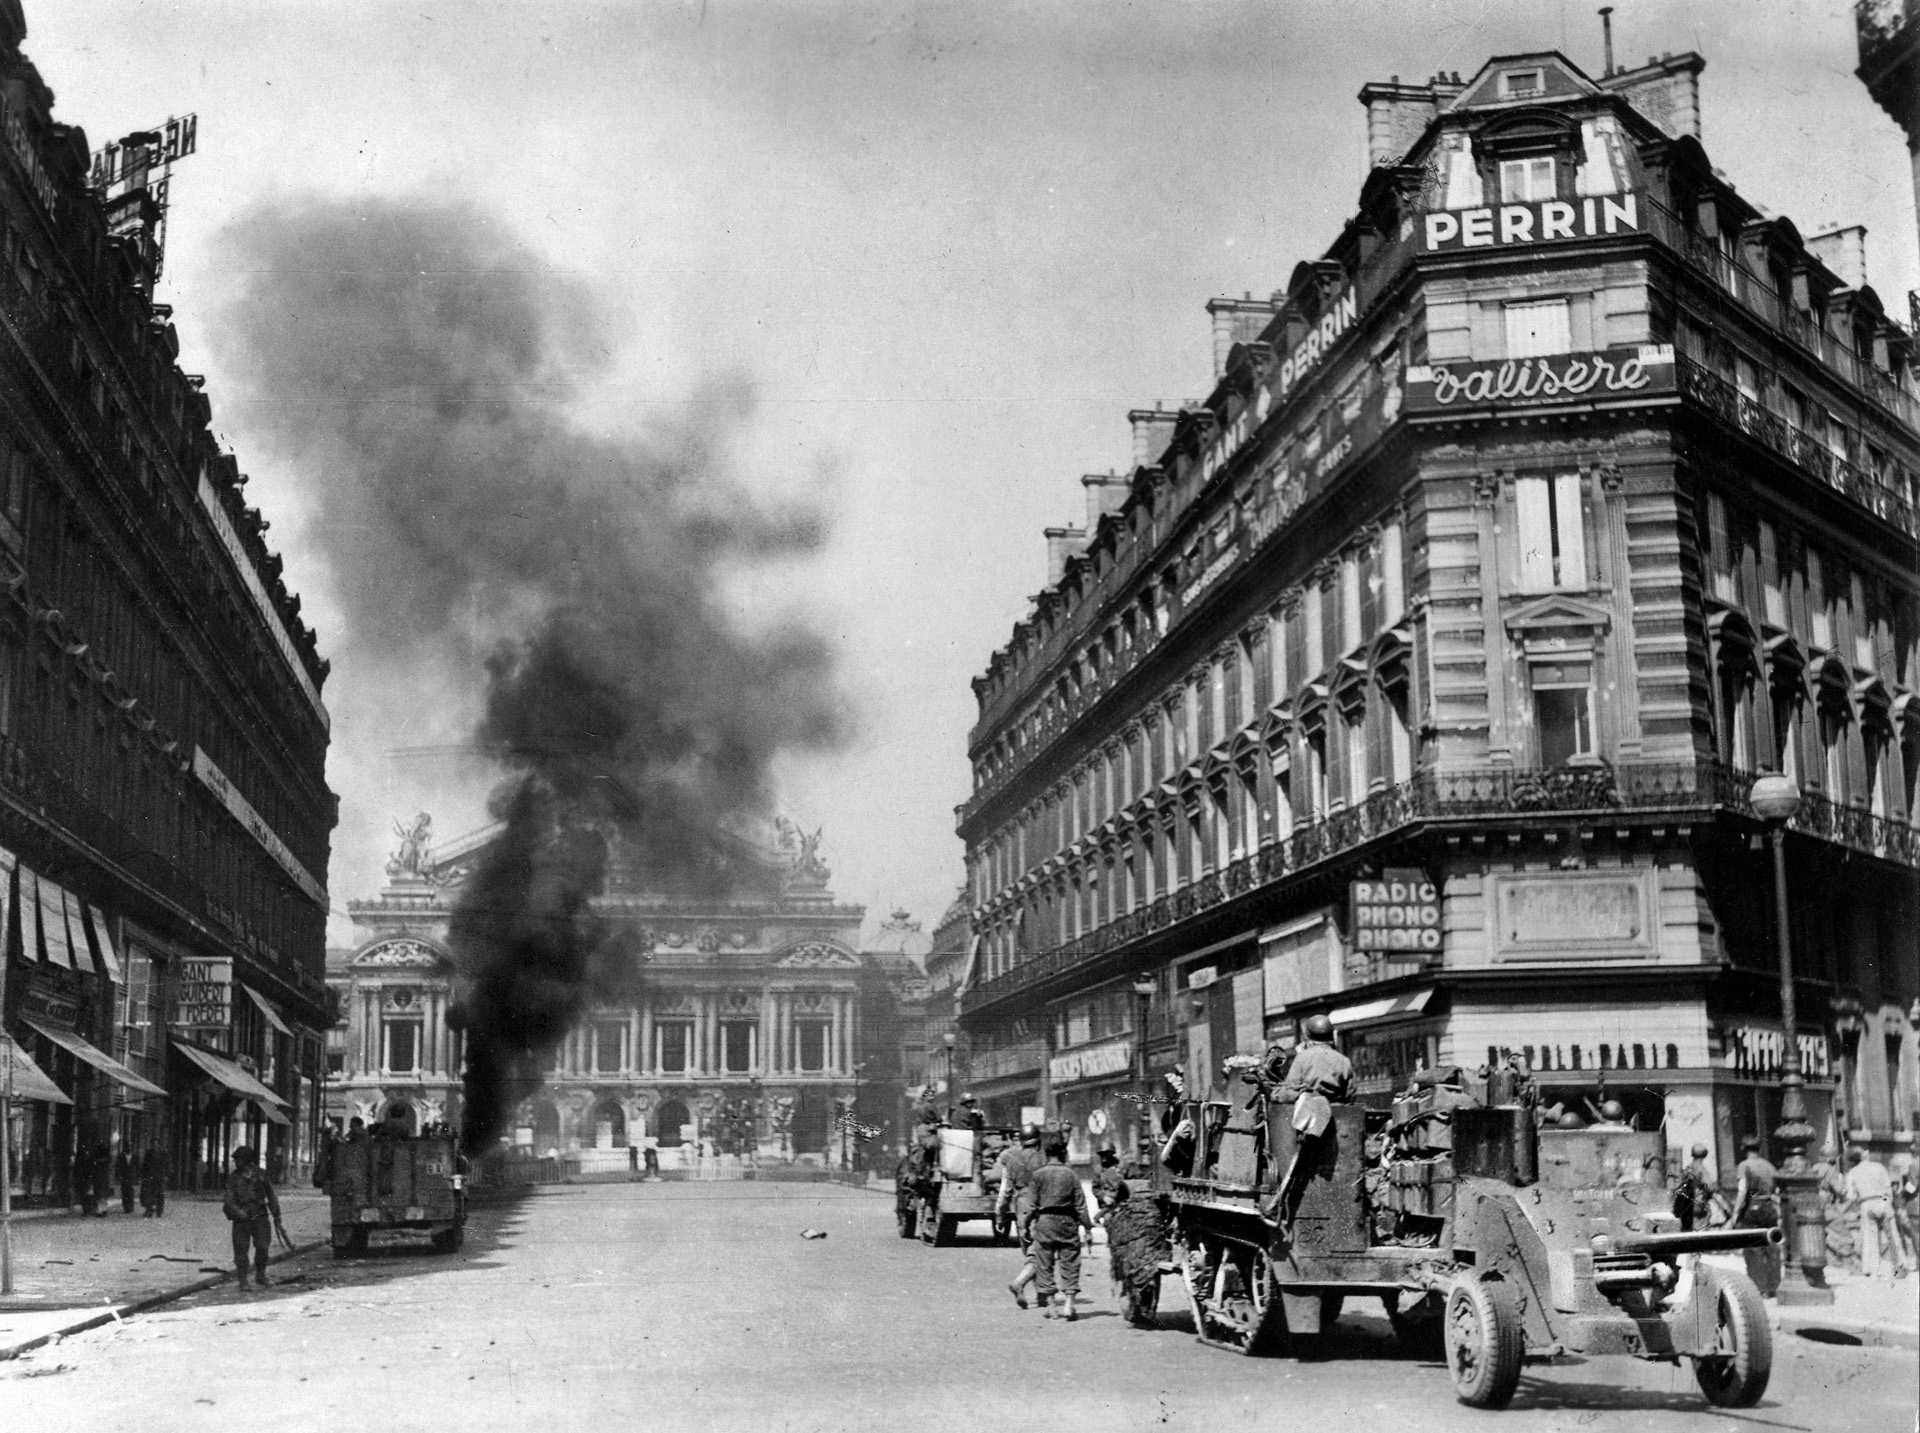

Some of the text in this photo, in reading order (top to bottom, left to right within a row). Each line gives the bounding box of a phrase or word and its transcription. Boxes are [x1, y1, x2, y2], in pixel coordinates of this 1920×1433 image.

[1425, 194, 1638, 250] PERRIN
[1281, 285, 1357, 394] PERRIN
[1356, 883, 1437, 902] RADIO
[1357, 906, 1439, 927] PHONO
[1358, 928, 1440, 948] PHOTO
